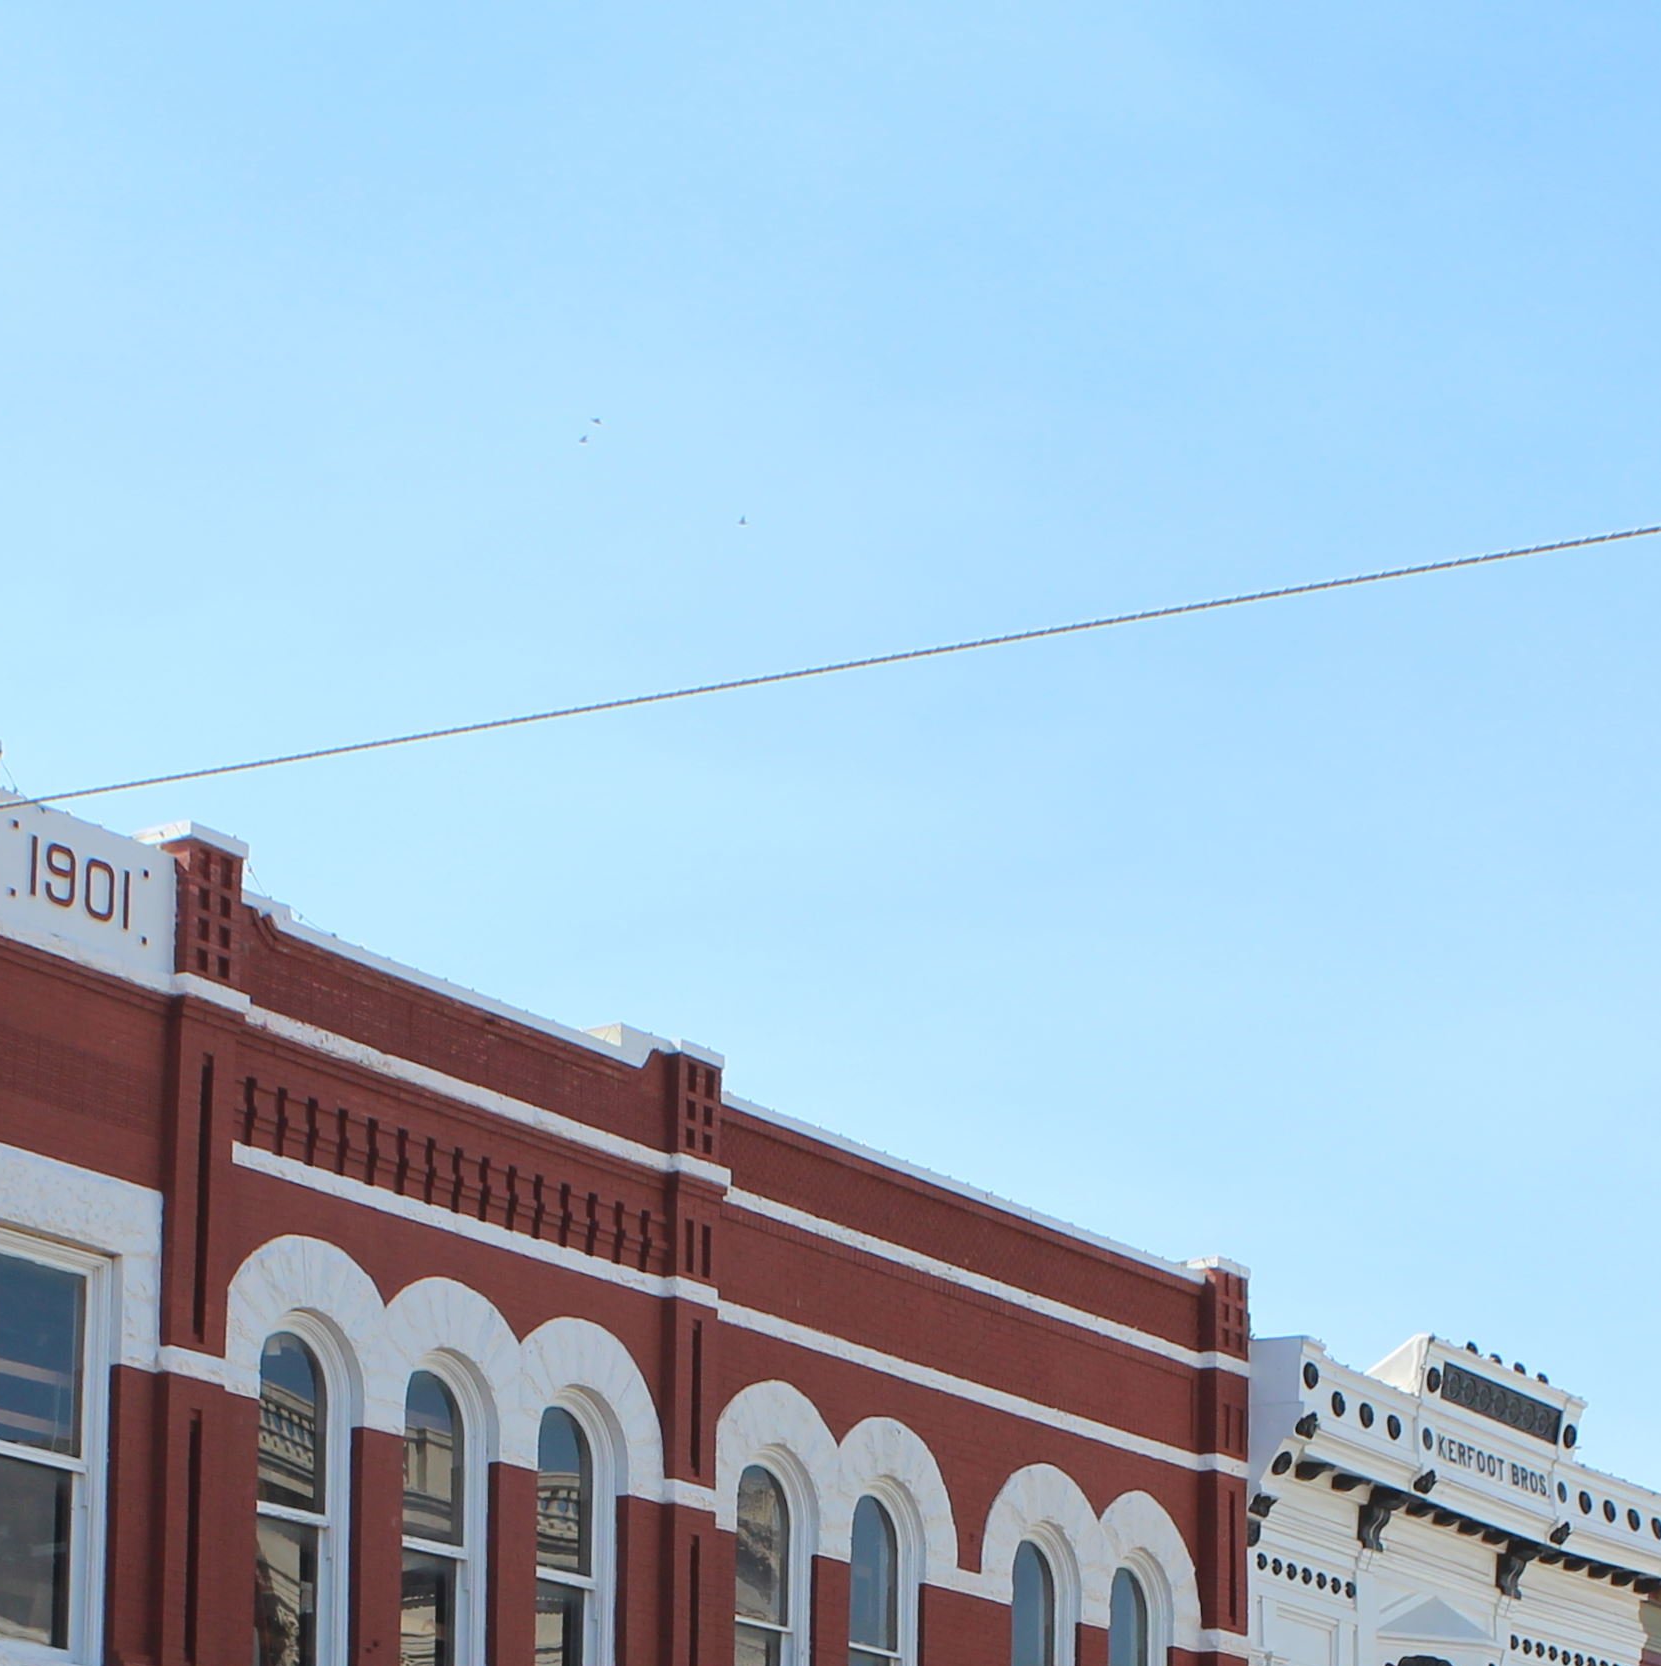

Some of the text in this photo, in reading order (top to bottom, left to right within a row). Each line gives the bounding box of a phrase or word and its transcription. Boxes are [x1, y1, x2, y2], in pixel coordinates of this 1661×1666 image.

[29, 834, 130, 930] 1901
[1437, 1433, 1552, 1499] KERFOOT BROS.
